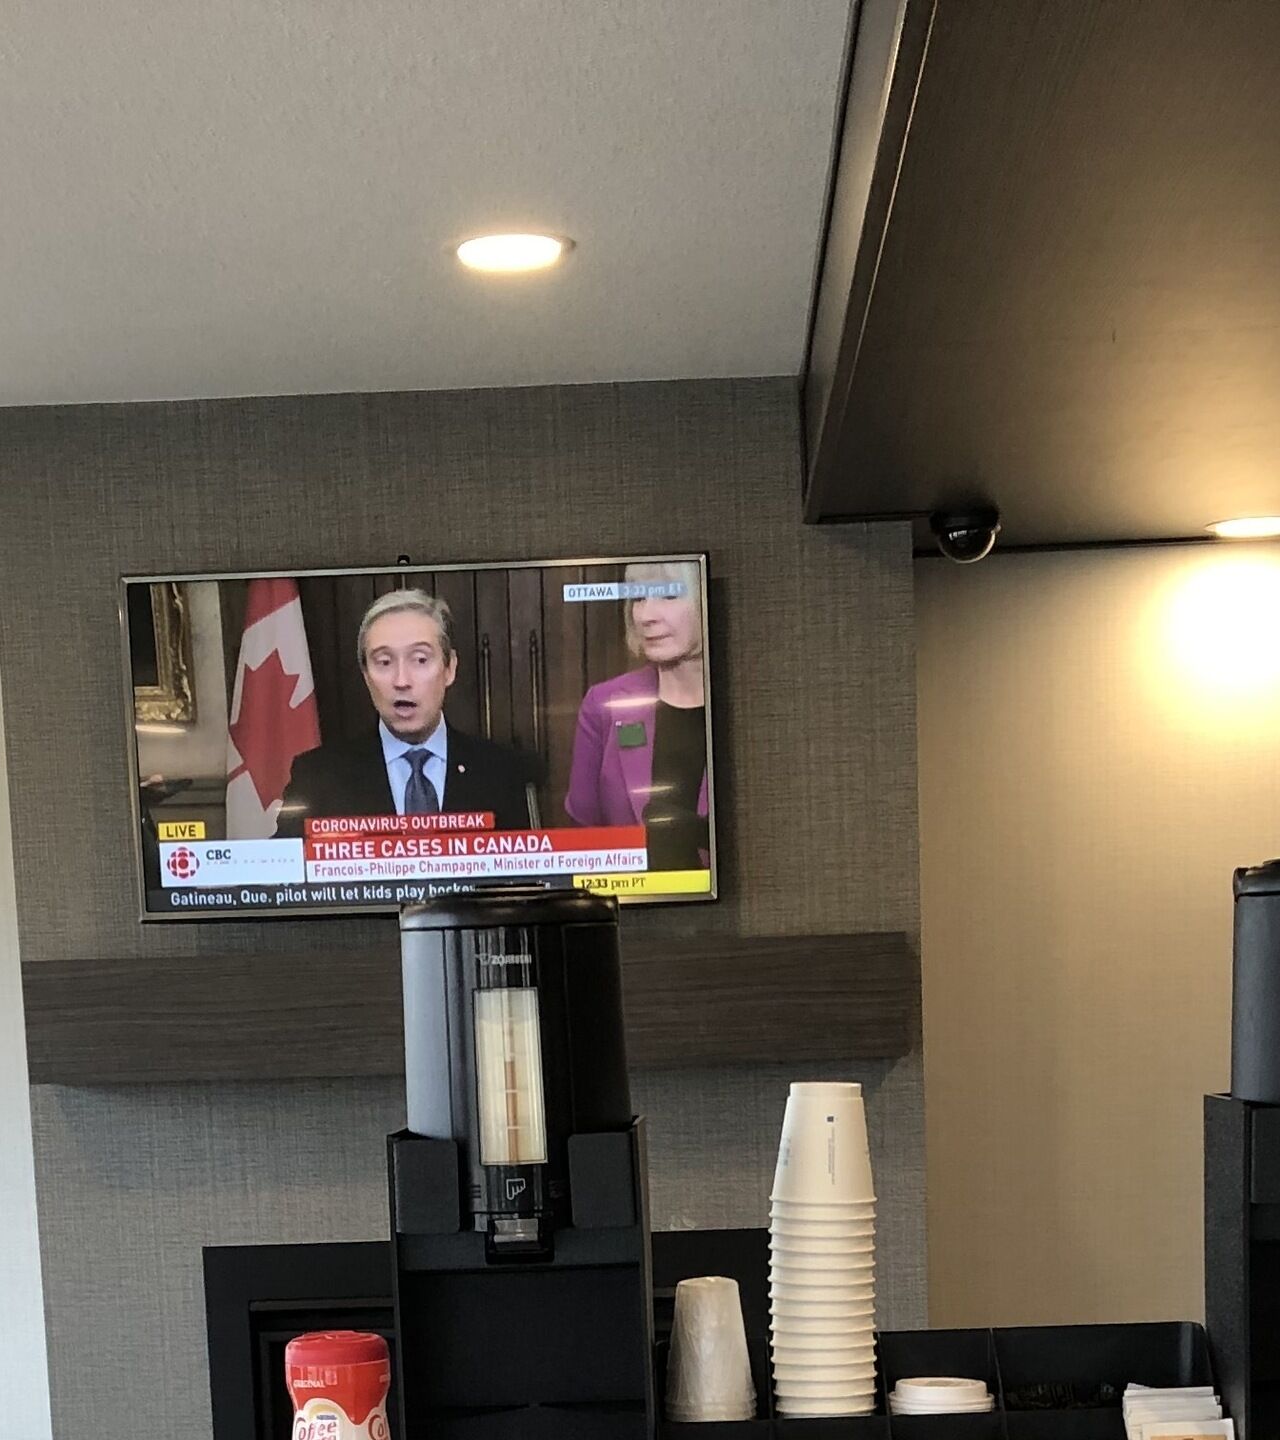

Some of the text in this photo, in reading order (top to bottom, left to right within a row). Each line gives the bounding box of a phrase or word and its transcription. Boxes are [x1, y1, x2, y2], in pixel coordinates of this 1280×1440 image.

[568, 585, 614, 598] OTTAWA
[166, 824, 197, 838] LIVE
[311, 814, 485, 832] CORONAVIRUS OUTBREAK
[205, 849, 232, 860] CBC
[312, 834, 553, 860] THREE CASES IN CANADA
[314, 852, 643, 877] Francois-Philippe Champagne, Minister of Foreign Affairs
[580, 877, 646, 890] 12:33 pm PT
[170, 890, 237, 906] Gatineau,
[240, 889, 272, 904] Que.
[276, 887, 307, 906] pilot
[311, 887, 337, 901] will
[340, 886, 359, 900] let
[363, 884, 392, 899] kids
[396, 883, 425, 903] play
